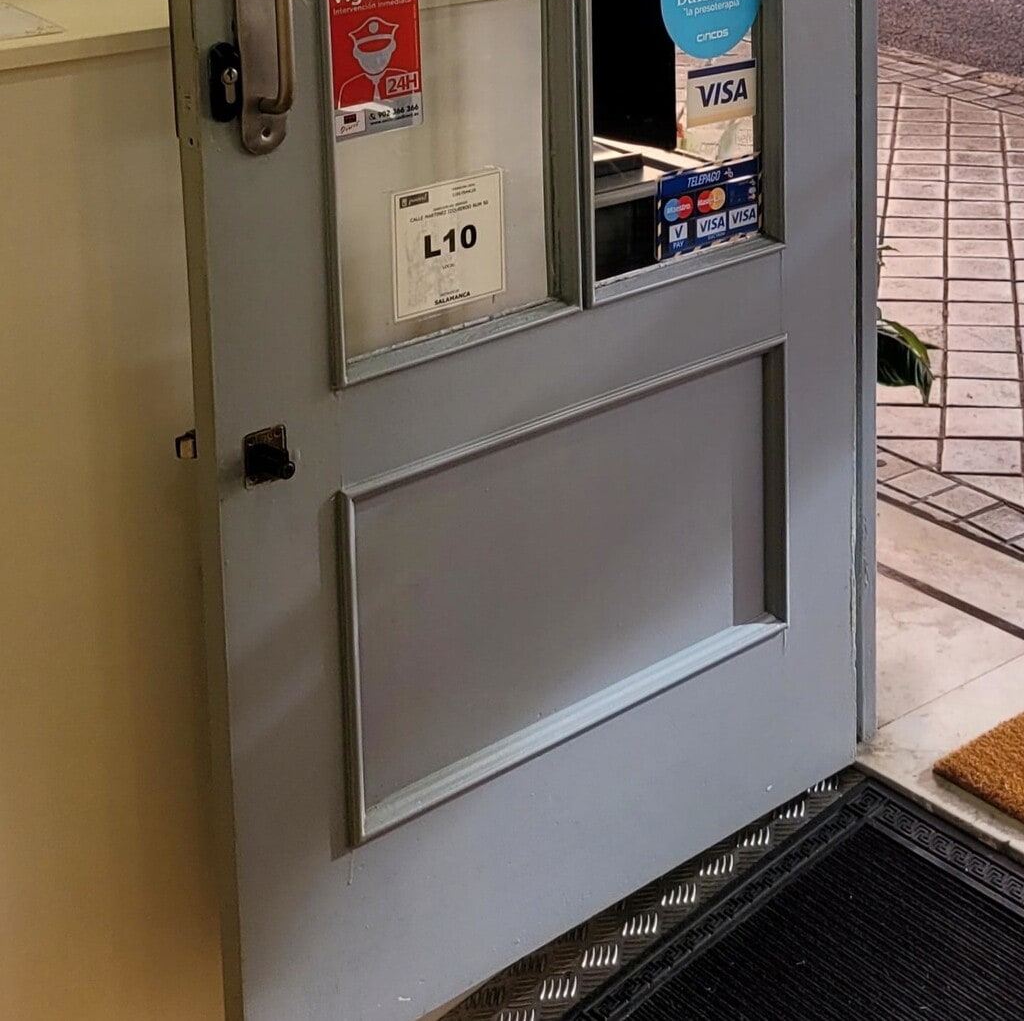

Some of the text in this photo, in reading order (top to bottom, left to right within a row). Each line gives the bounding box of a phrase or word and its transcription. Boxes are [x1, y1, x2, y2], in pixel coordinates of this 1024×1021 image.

[387, 77, 418, 94] 24H
[695, 77, 748, 108] VISA
[687, 170, 721, 188] TELEPAGO
[700, 217, 727, 233] VISA
[732, 207, 756, 225] VISA
[424, 224, 477, 259] L10
[434, 290, 471, 306] SALAMANCA
